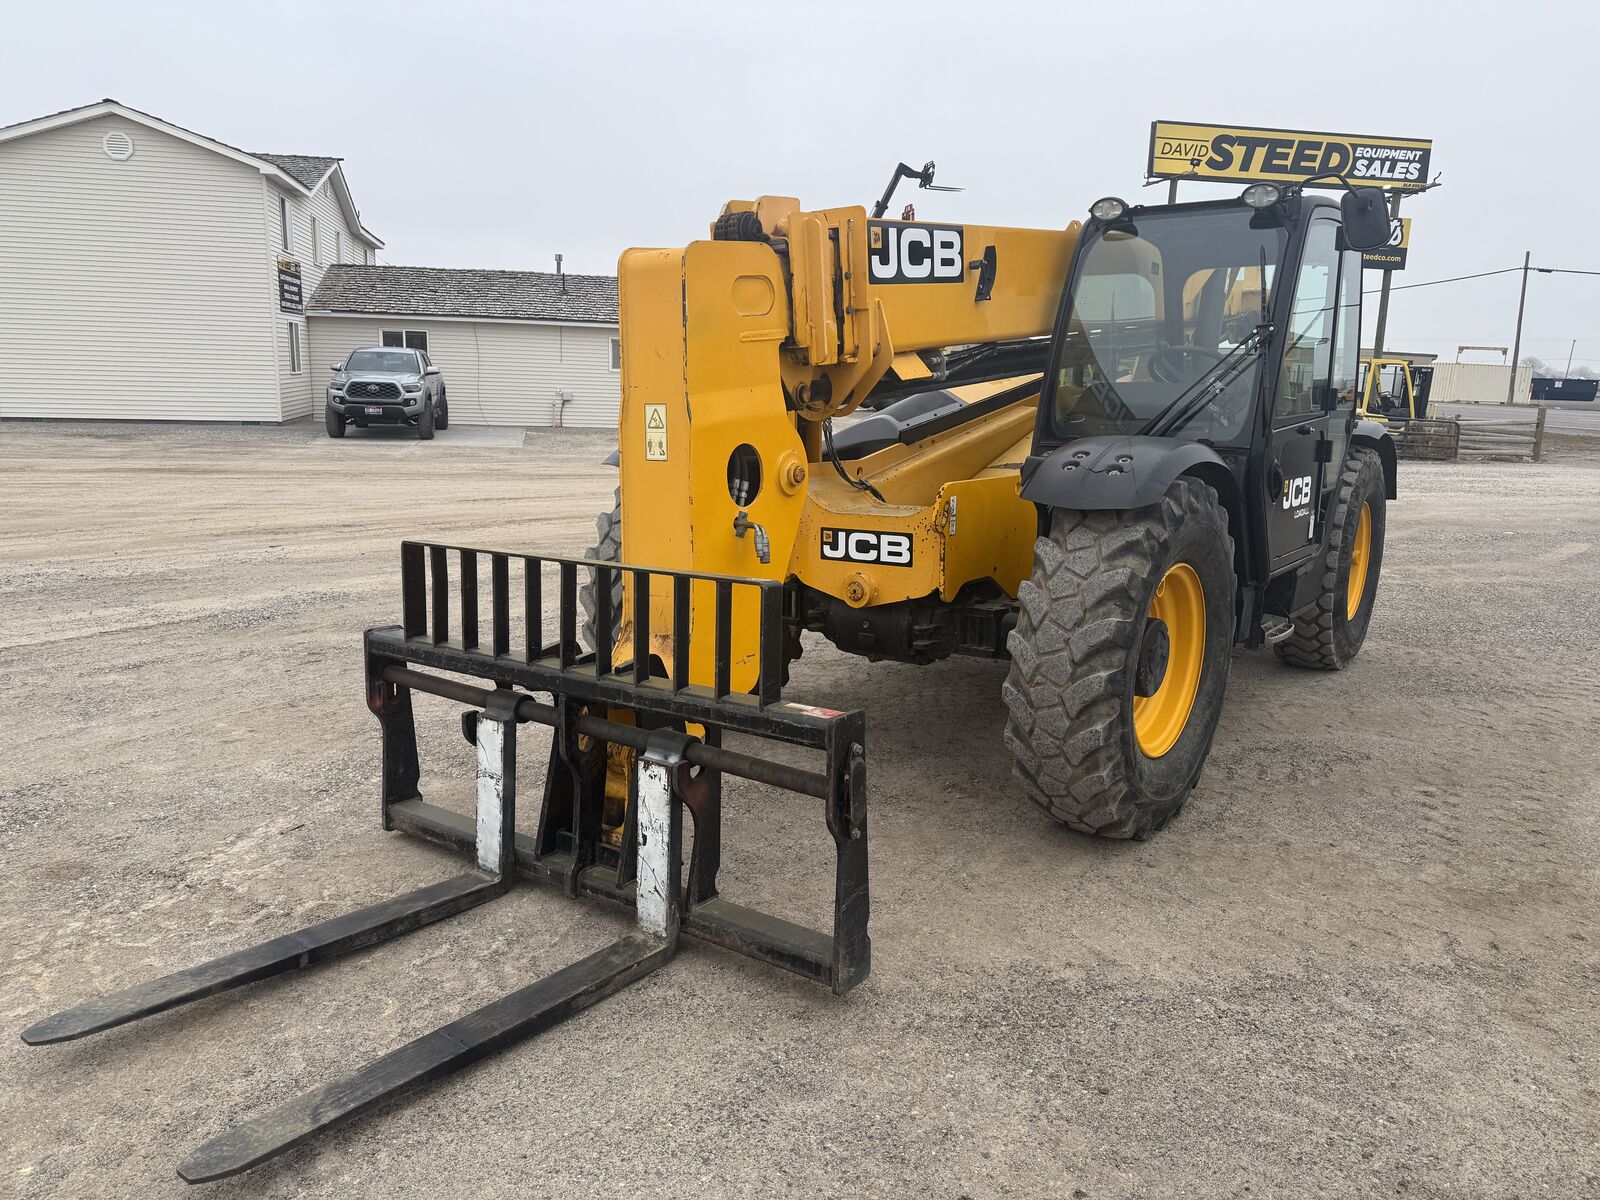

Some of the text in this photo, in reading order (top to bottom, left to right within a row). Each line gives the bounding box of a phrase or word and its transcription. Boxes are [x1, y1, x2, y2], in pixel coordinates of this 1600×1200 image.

[1161, 142, 1209, 158] DAVID
[1205, 133, 1351, 176] STEED
[1355, 146, 1423, 161] EQUIPMENT
[1353, 158, 1422, 180] SALES
[870, 227, 962, 279] JCB
[1363, 253, 1402, 262] teedco.com
[1283, 475, 1312, 510] JCB
[823, 531, 911, 564] JCB
